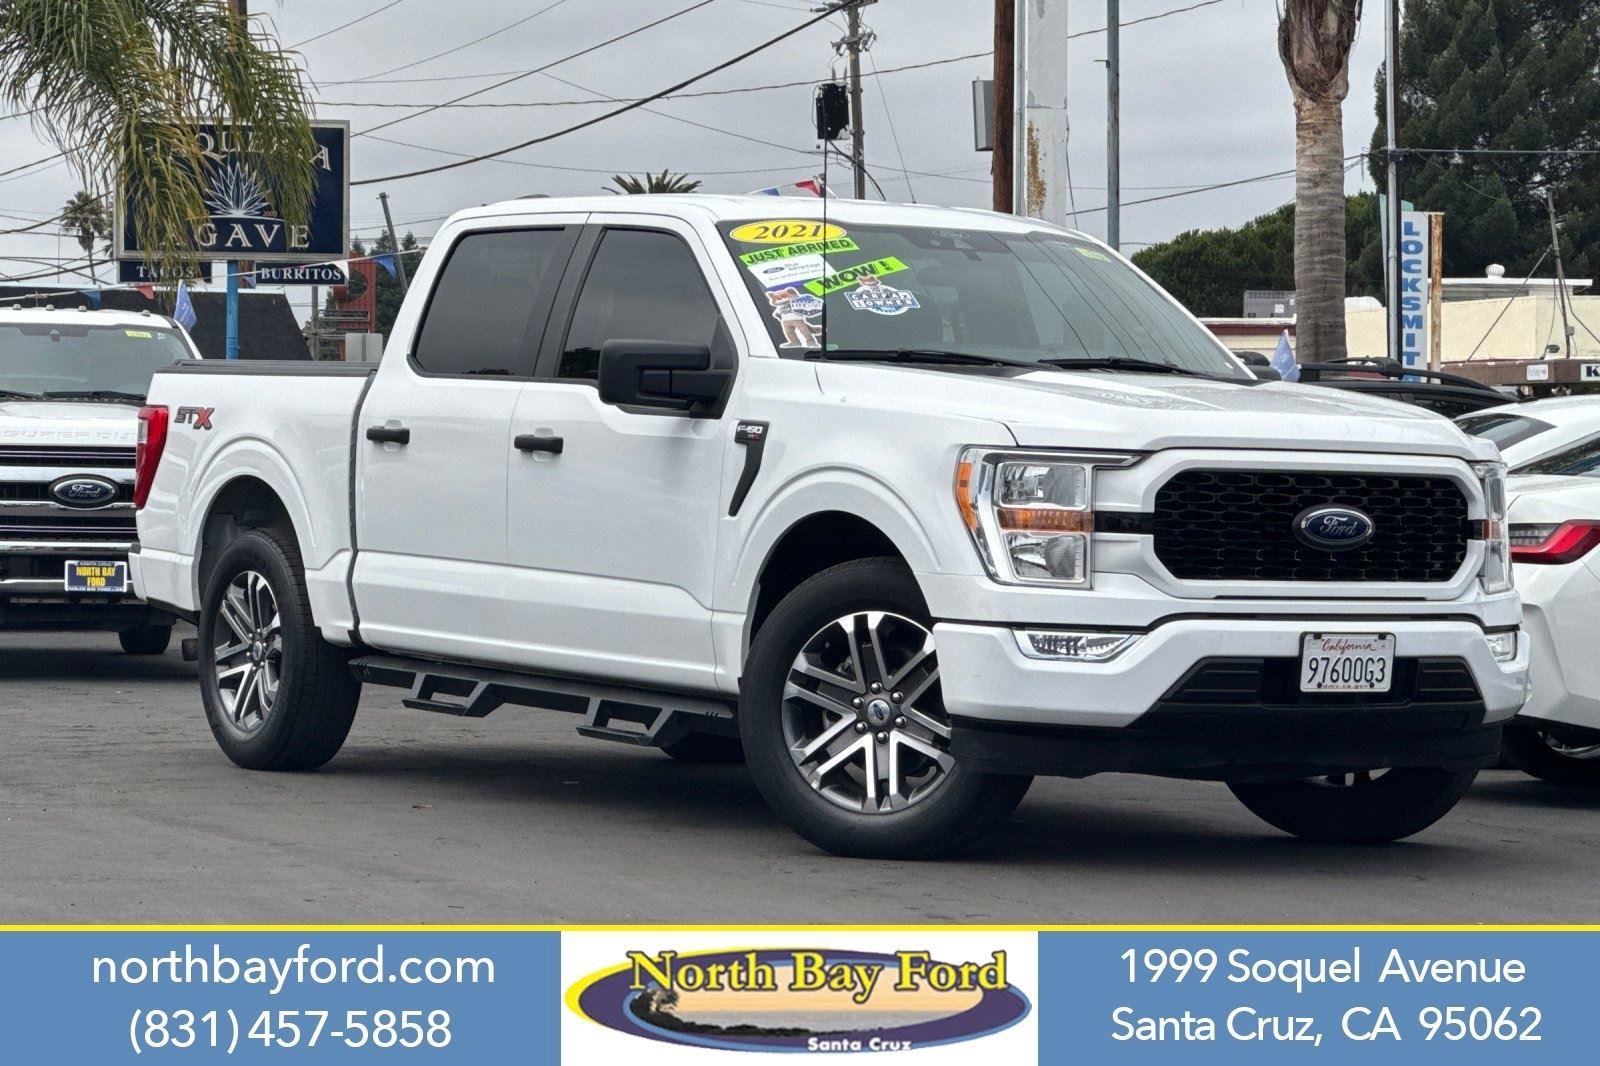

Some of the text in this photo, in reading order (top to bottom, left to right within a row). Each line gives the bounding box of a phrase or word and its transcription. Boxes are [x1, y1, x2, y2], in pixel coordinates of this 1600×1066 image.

[160, 223, 310, 248] GAVE
[753, 224, 822, 240] 2021
[747, 239, 851, 264] JUST ARRIVED
[261, 267, 342, 281] BURRITOS
[174, 406, 215, 430] STX
[71, 483, 100, 498] Ford
[1320, 516, 1358, 535] Ford
[76, 566, 116, 576] NORTH BAY
[87, 577, 106, 587] FORD
[1322, 638, 1377, 655] California
[1307, 657, 1386, 683] 97600G3
